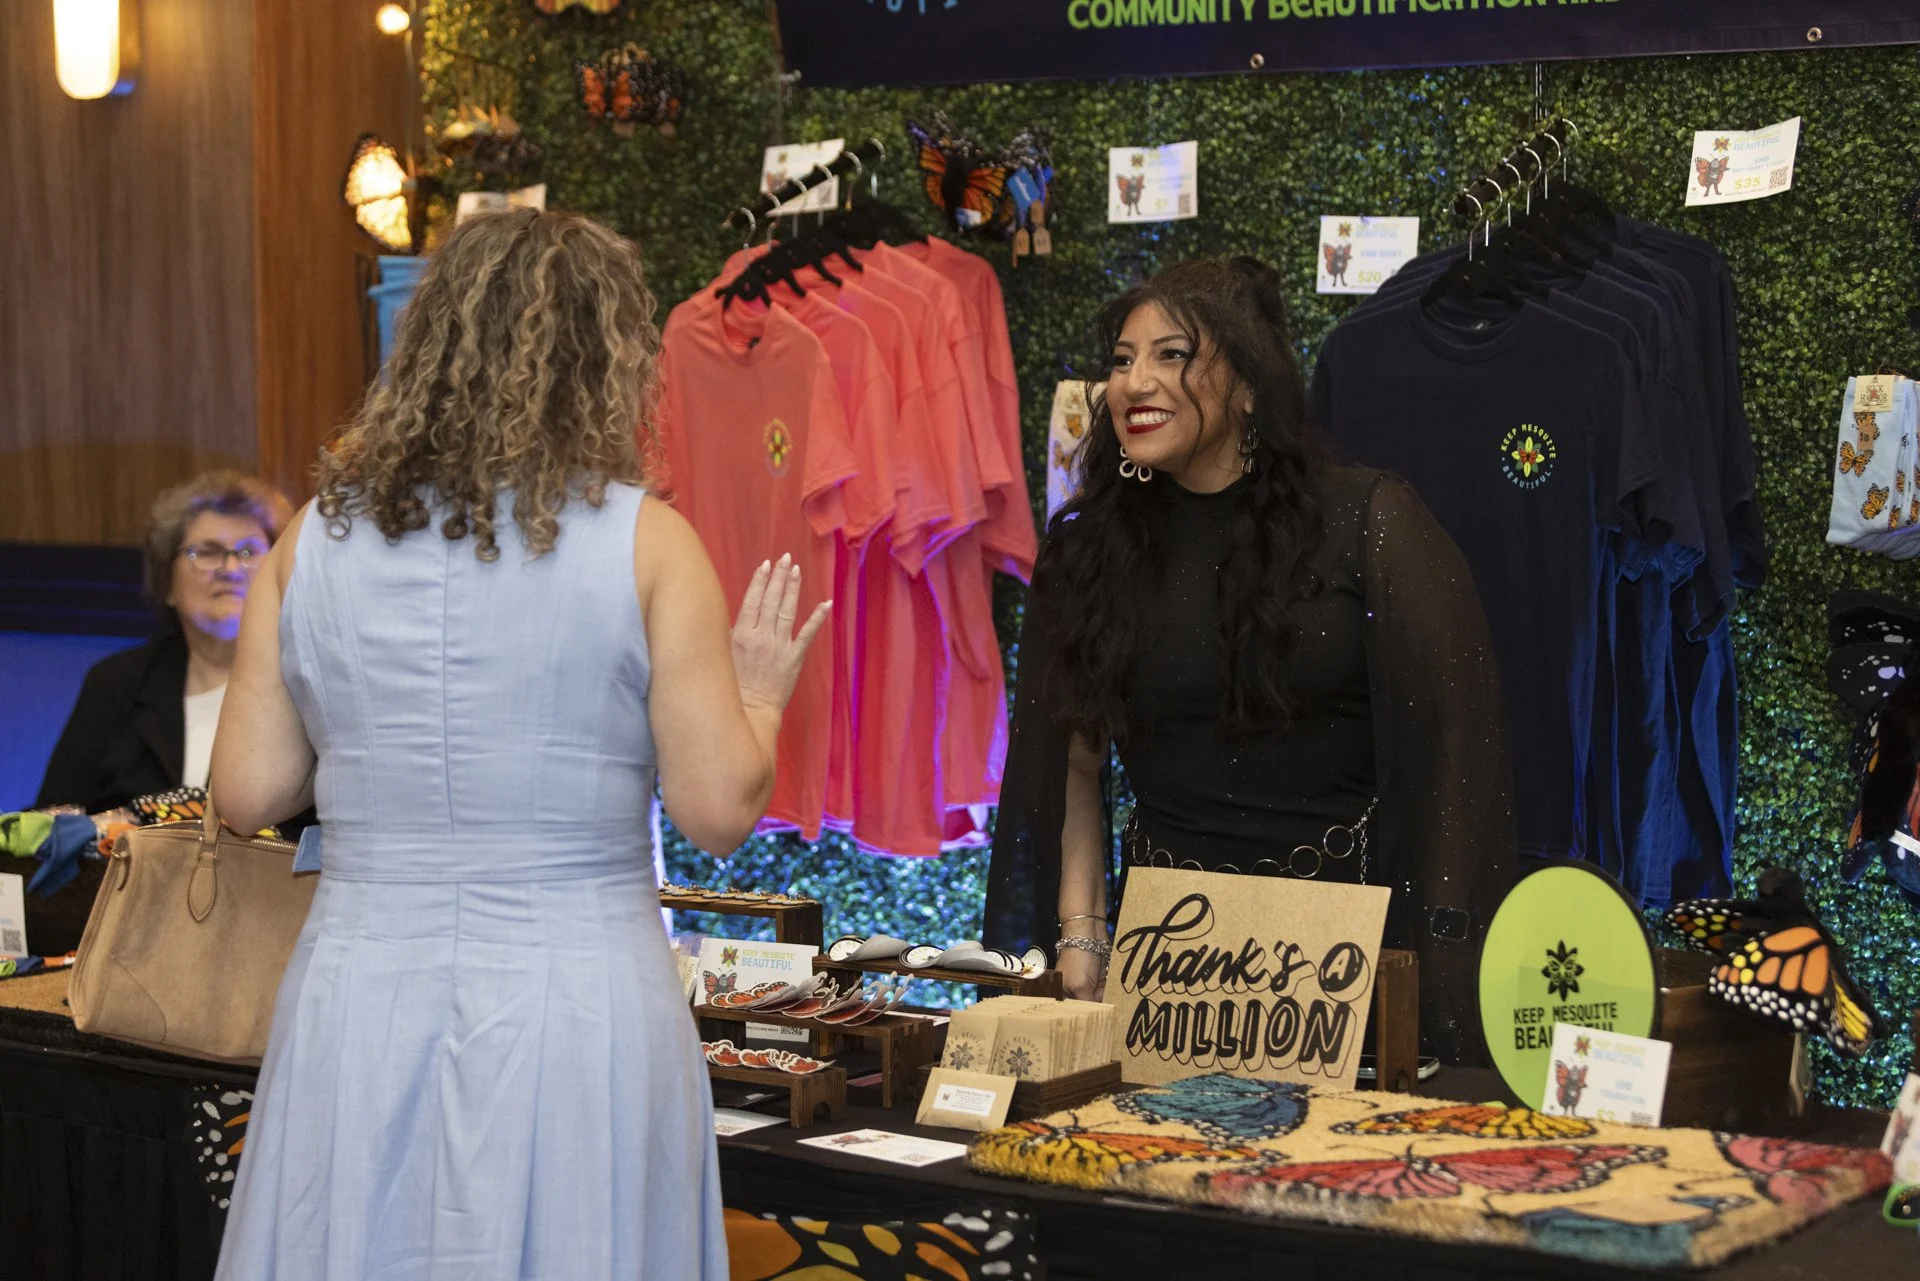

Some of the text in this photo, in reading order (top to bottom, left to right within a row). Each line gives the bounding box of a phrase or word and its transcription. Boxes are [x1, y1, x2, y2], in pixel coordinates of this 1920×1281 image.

[1067, 0, 1548, 29] COMMUNITY BEAUTIF
[1734, 176, 1761, 190] $35
[1358, 271, 1382, 283] $20
[1500, 423, 1557, 459] KEEP MESQUITE
[1502, 465, 1552, 490] BEAUTIFUL
[741, 957, 793, 971] BEAUTIFUL
[1513, 1002, 1618, 1024] KEEP MESQUITE
[1126, 996, 1357, 1078] MILLION
